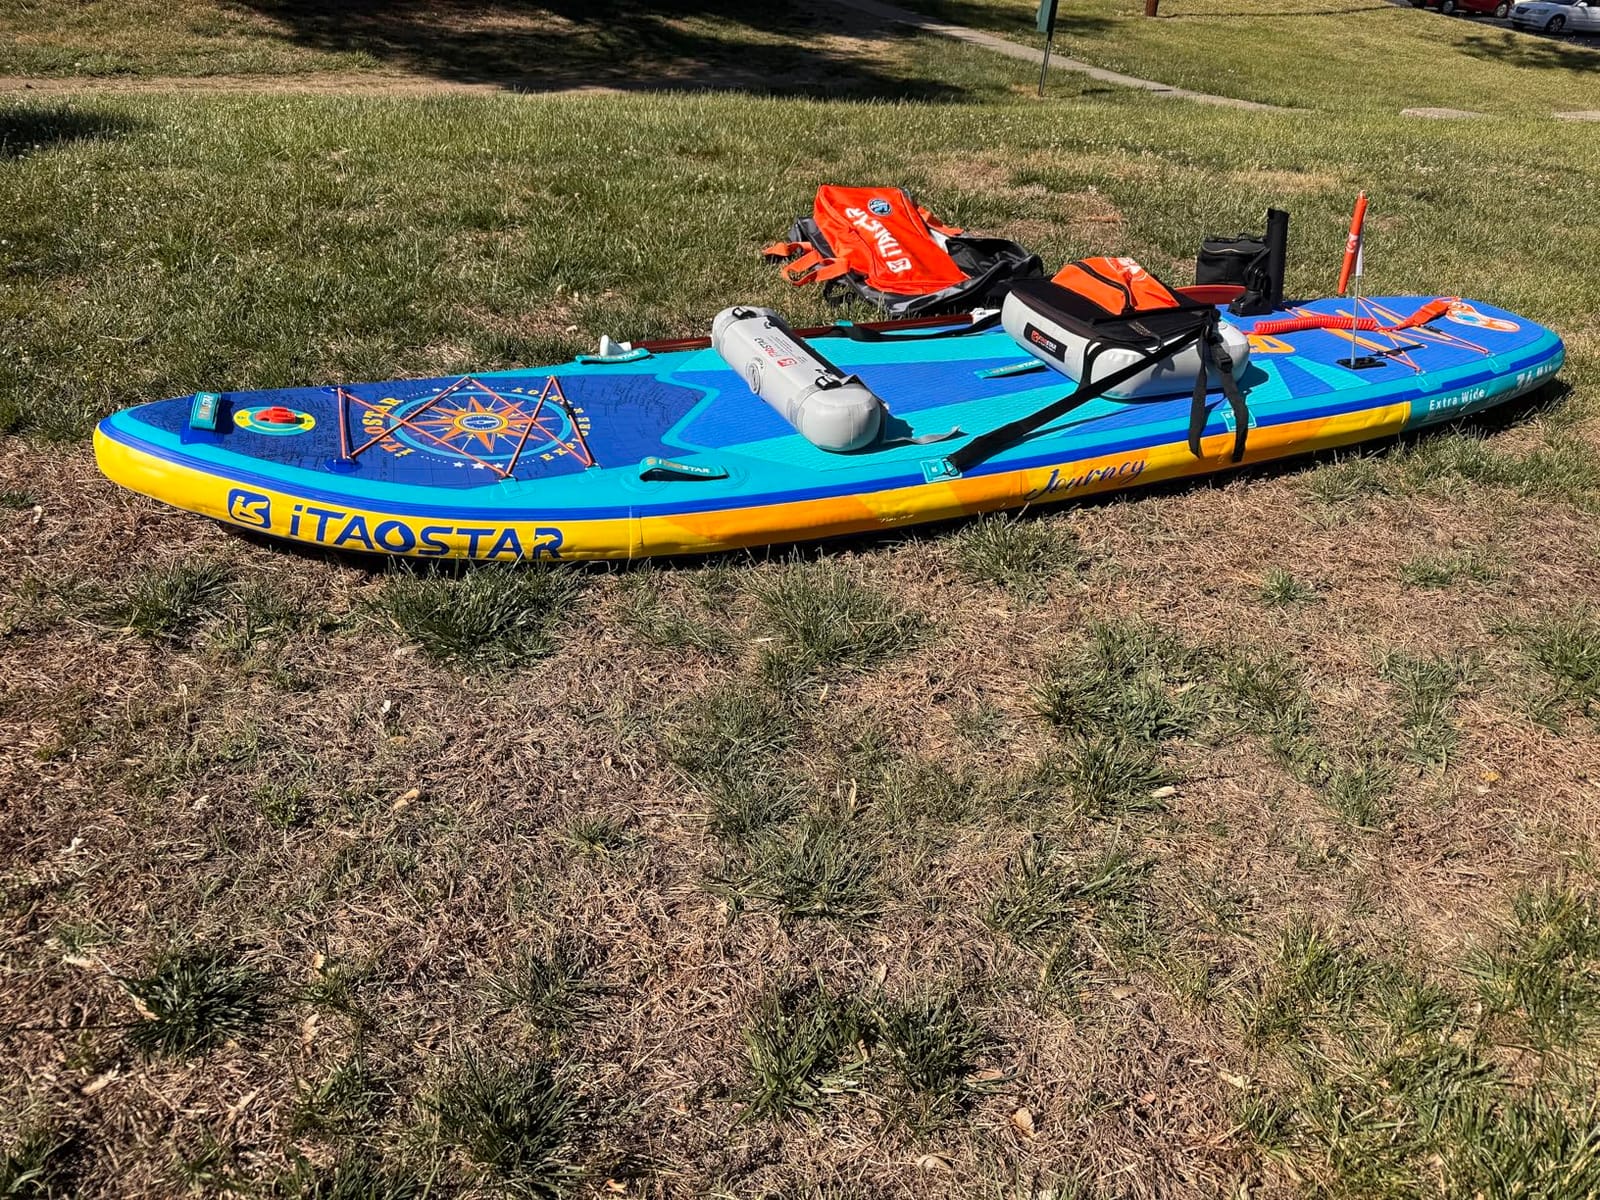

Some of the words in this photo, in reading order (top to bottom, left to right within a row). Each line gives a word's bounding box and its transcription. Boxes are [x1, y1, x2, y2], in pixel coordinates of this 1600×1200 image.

[1429, 396, 1457, 411] Extra
[1461, 388, 1485, 402] Wide
[1024, 459, 1147, 501] Journey
[289, 504, 564, 561] iTAOSTAR
